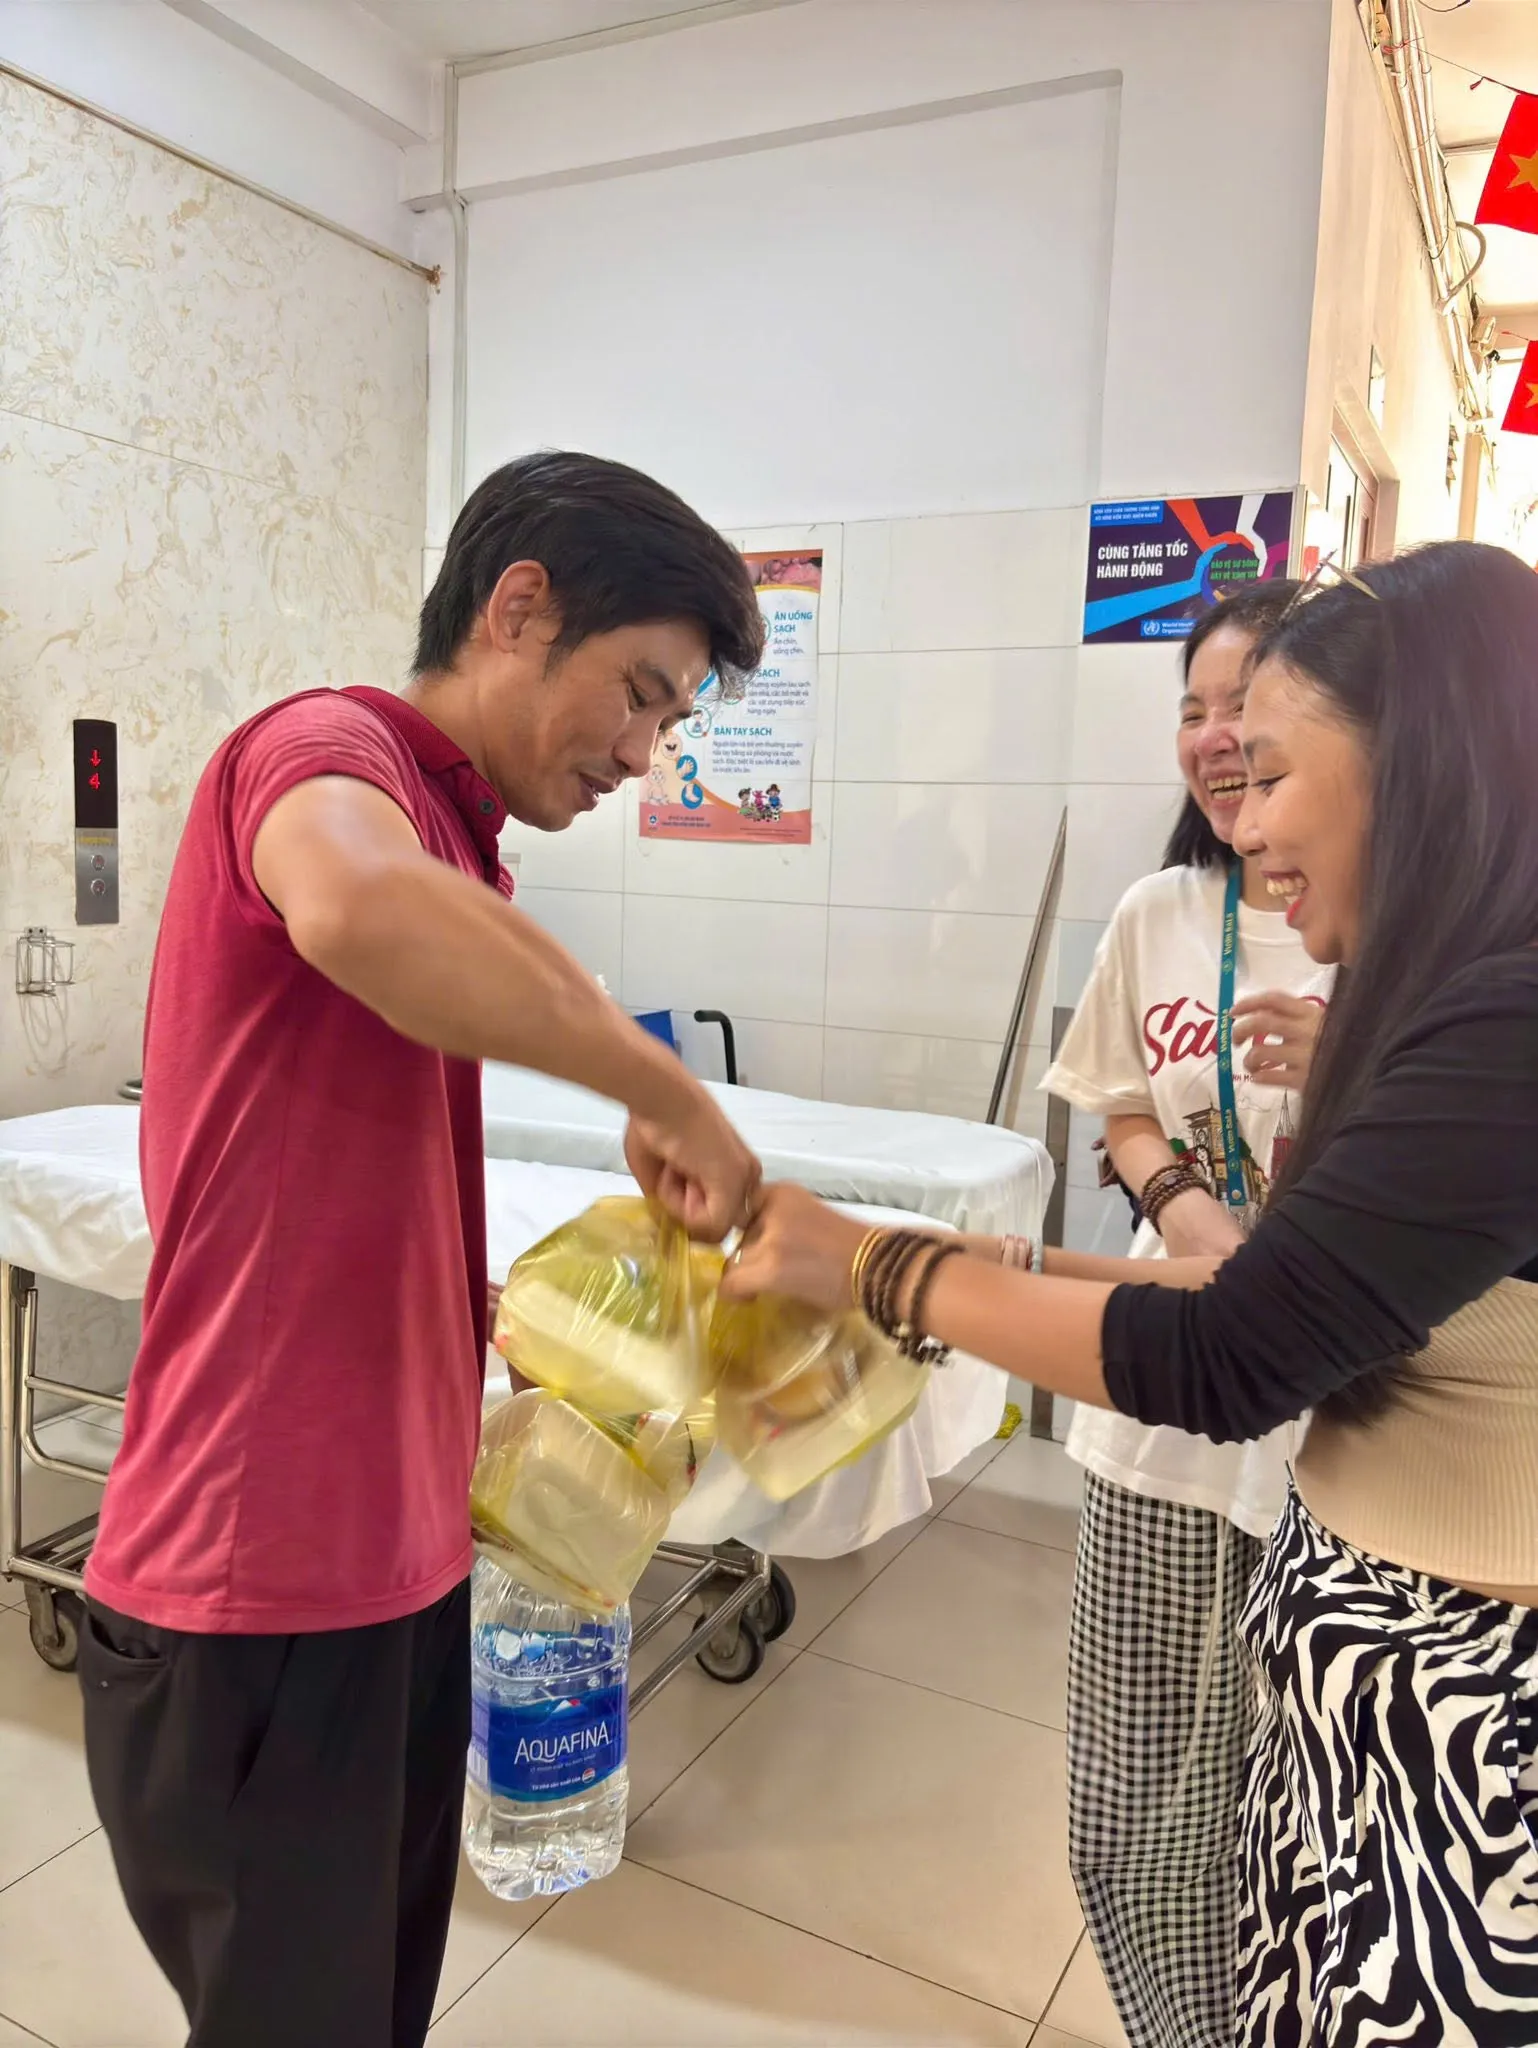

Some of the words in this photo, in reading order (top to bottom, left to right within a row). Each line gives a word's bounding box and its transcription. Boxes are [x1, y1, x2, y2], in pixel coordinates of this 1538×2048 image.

[1098, 542, 1129, 560] CÙNG
[1132, 541, 1163, 558] TĂNG
[1165, 538, 1189, 557] TỐC
[1096, 561, 1128, 579] HÀNH
[1130, 561, 1164, 580] ĐỘNG
[774, 610, 786, 620] ĂN
[788, 609, 813, 621] UỐNG
[773, 624, 796, 635] SẠCH
[756, 668, 780, 679] SẠCH
[714, 726, 732, 736] BÀN
[732, 727, 749, 736] TAY
[749, 727, 772, 737] SẠCH
[88, 772, 101, 791] 4
[513, 1720, 610, 1765] AQUAFINA
